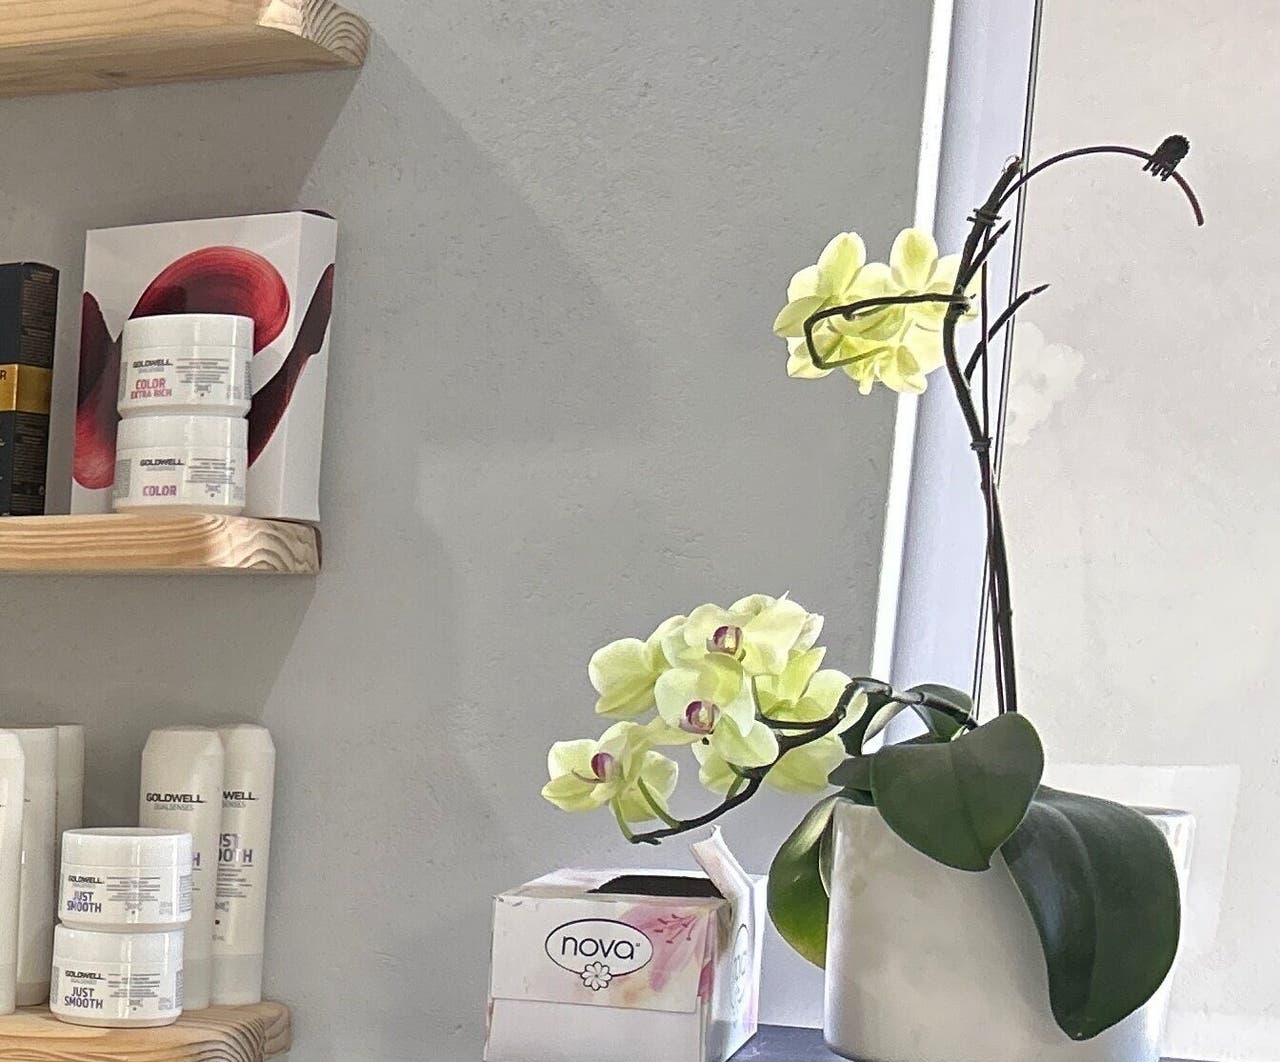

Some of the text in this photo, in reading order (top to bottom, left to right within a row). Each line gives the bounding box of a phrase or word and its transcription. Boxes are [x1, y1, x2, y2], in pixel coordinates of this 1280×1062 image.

[132, 359, 174, 369] GOLDWELL
[135, 378, 166, 390] COLOR
[130, 389, 173, 400] EXTRA RICH
[140, 459, 185, 467] GOLDWELL
[142, 485, 177, 497] COLOR
[146, 792, 206, 803] GOLDWELL
[223, 791, 257, 800] WELL
[68, 875, 105, 884] GOLDWELL
[73, 891, 94, 902] JUST
[67, 900, 102, 913] SMOOTH
[561, 935, 634, 960] nova
[65, 970, 106, 980] GOLDWELL
[71, 987, 95, 998] JUST
[64, 996, 103, 1009] SMOOTH
